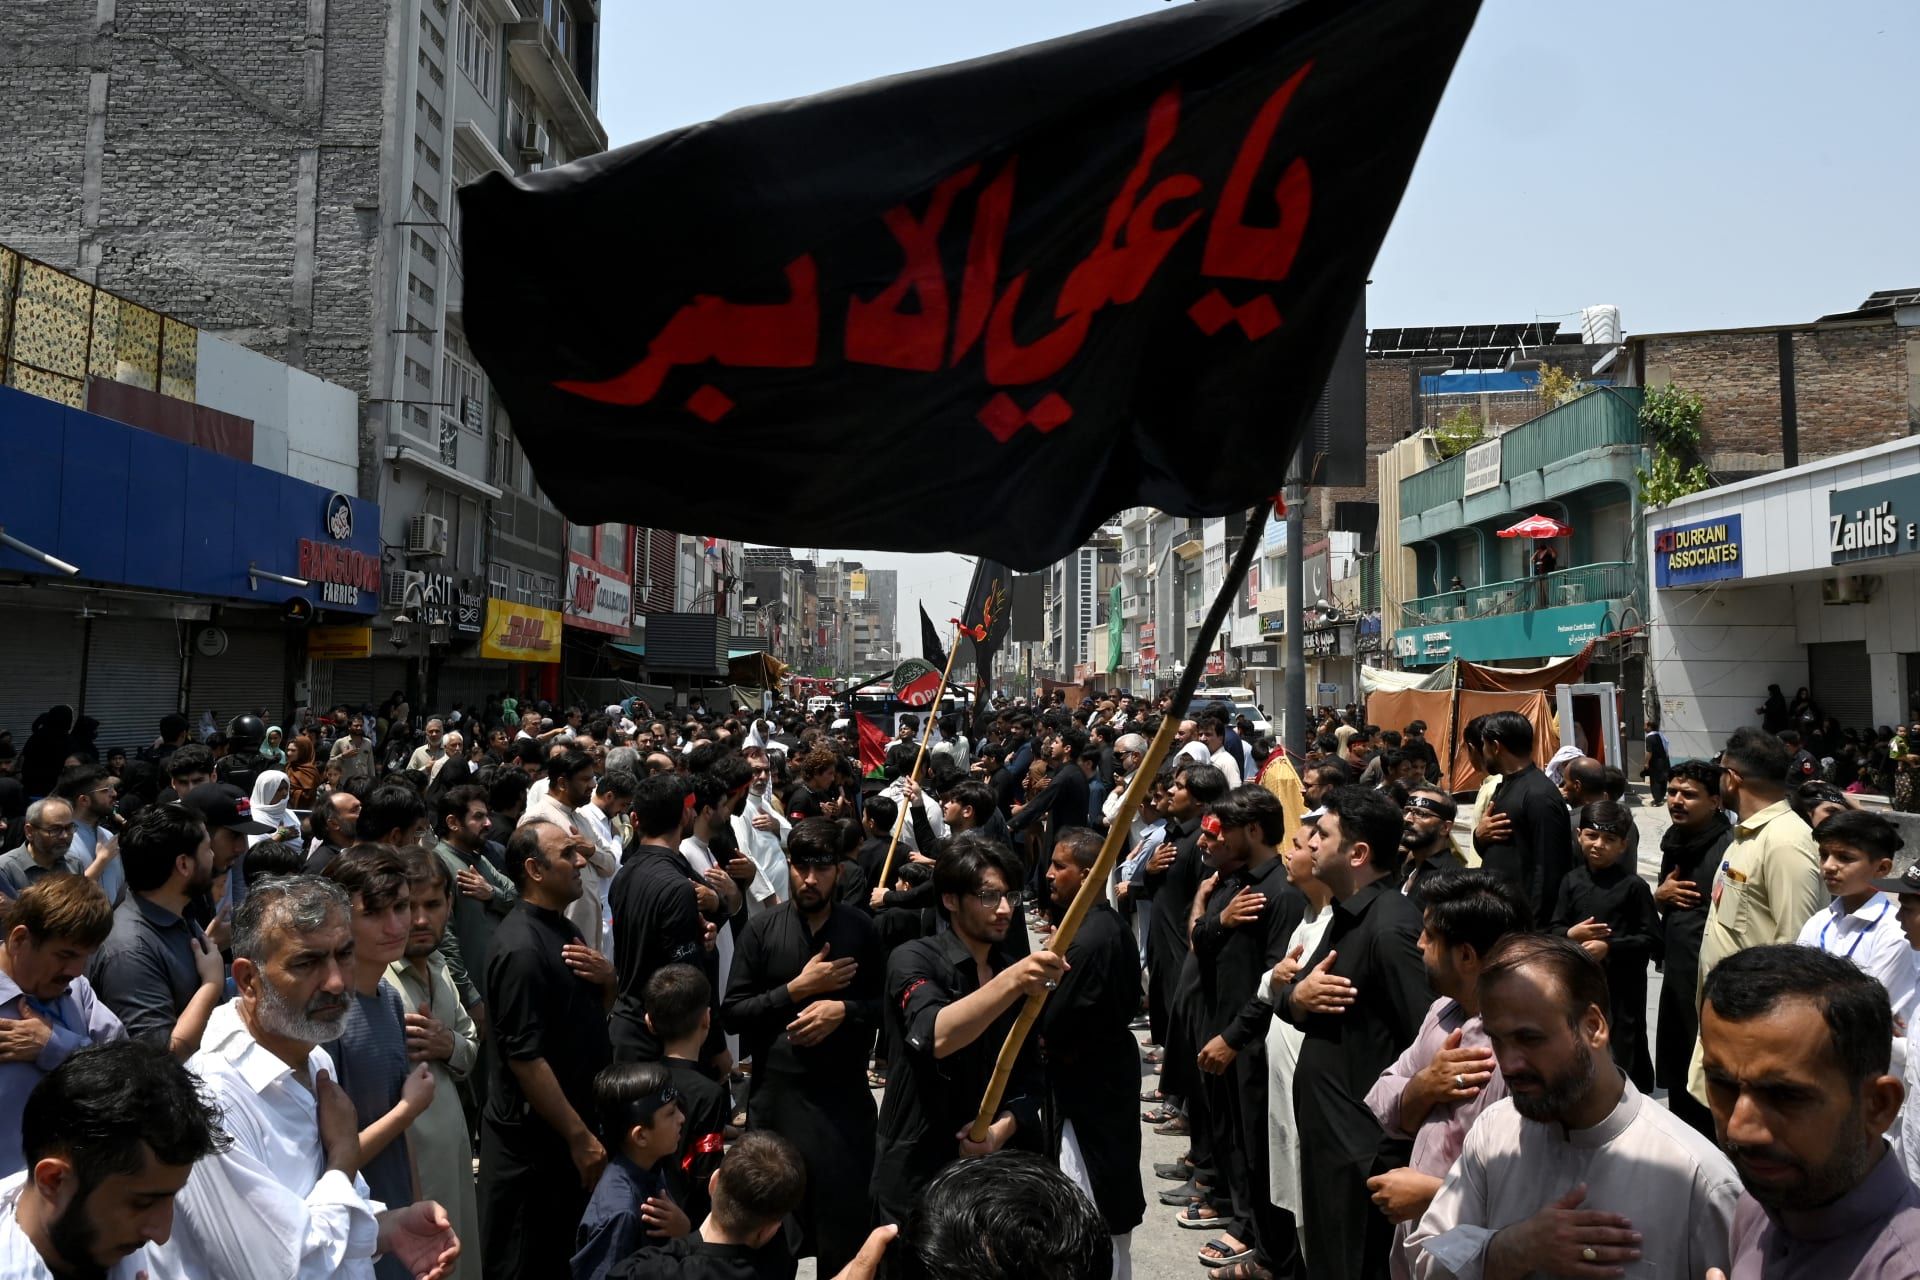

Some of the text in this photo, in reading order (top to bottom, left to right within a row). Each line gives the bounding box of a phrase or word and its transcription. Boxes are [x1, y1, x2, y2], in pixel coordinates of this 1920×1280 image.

[1675, 524, 1726, 549] DURRANI
[1668, 544, 1737, 570] ASSOCIATES
[323, 582, 359, 606] FABRICS
[424, 571, 453, 606] ASIT
[417, 606, 453, 627] FABRCS
